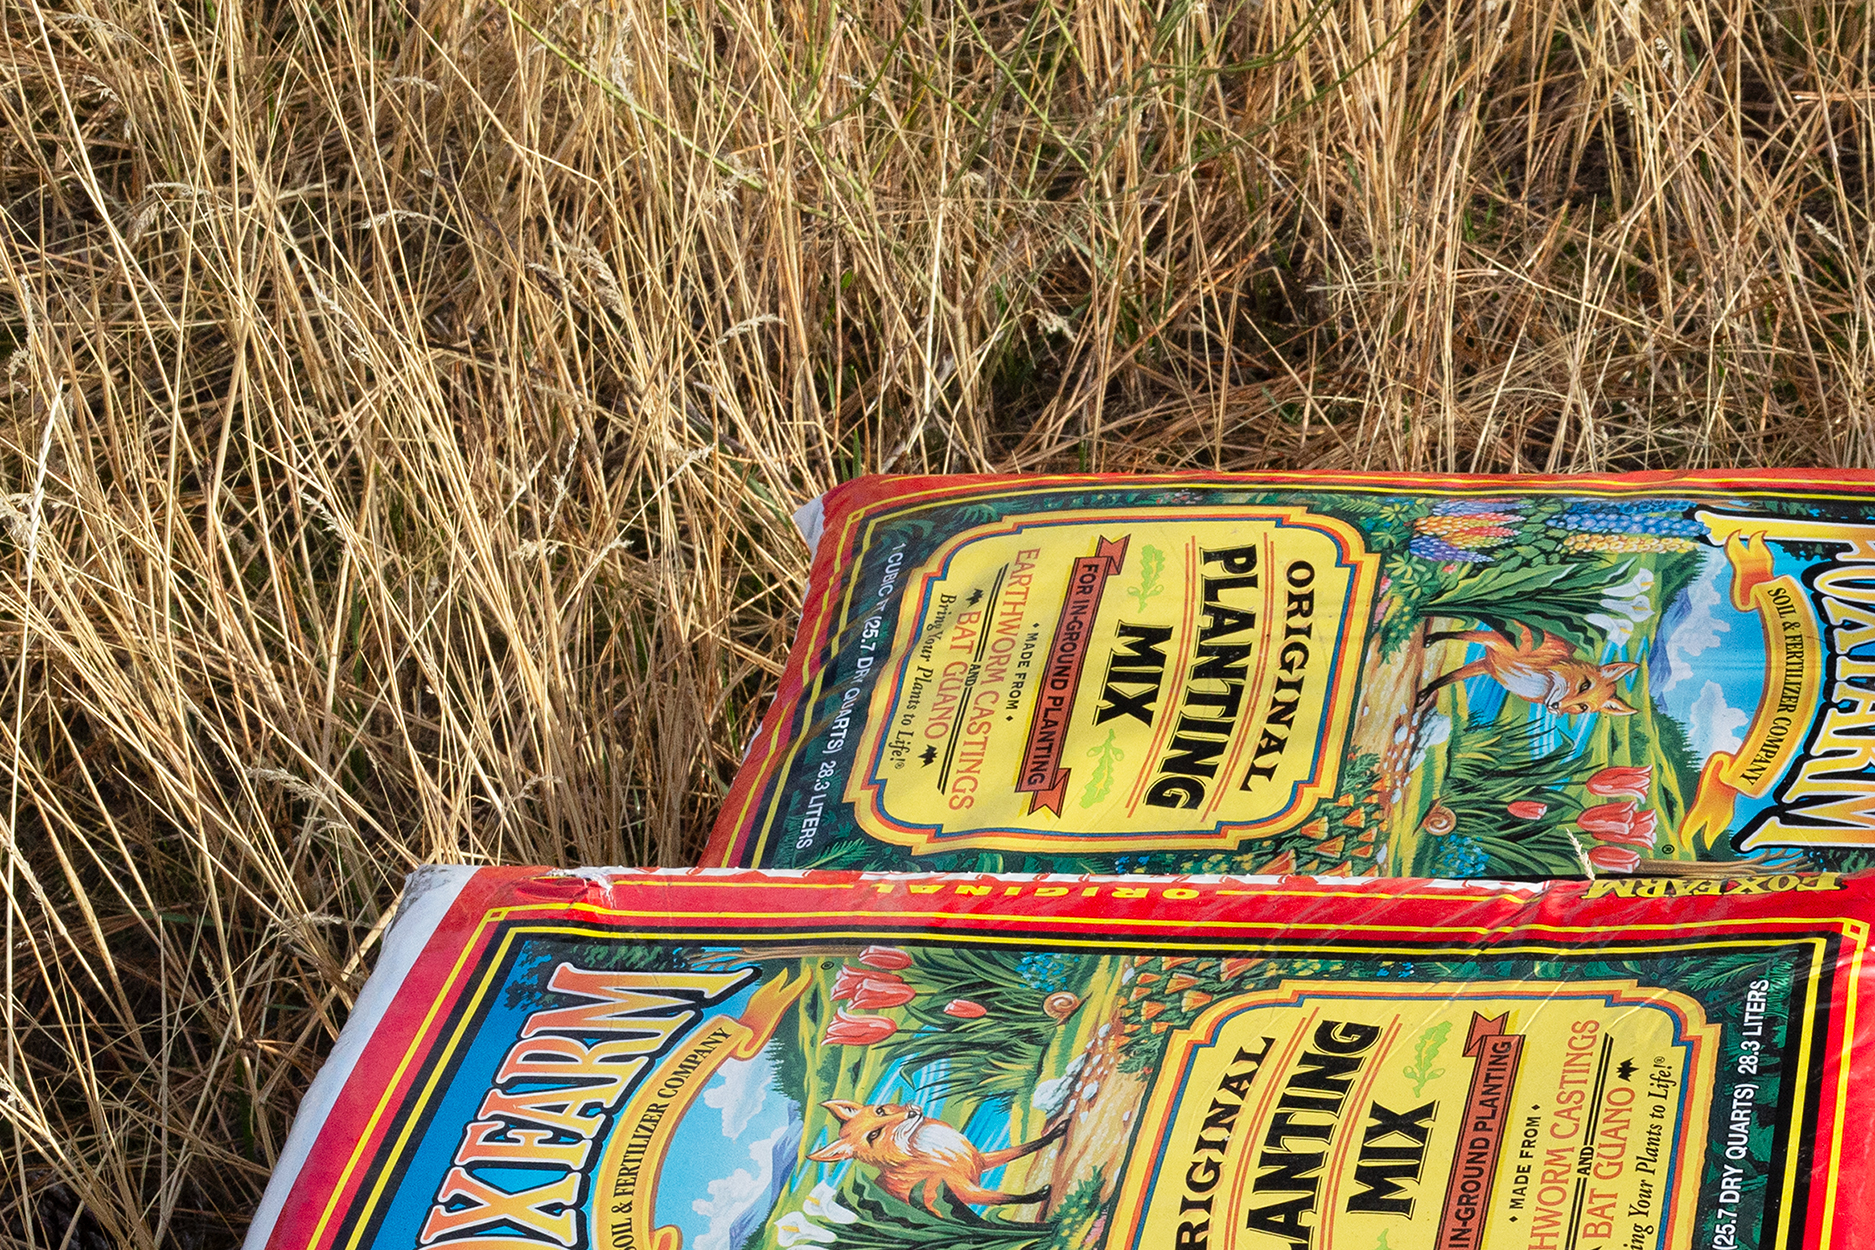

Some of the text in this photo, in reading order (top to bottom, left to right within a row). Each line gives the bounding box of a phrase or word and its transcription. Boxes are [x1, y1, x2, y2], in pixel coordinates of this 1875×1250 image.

[796, 551, 904, 850] CUBIC (25.7 DRY QUARTS) 28.3 LITERS
[901, 593, 957, 726] Bring Your Plants to
[925, 610, 975, 740] BAT GUANO
[948, 547, 1041, 811] EARTHWORM CASTINGS
[964, 662, 982, 687] AND
[1005, 632, 1039, 711] MADE FROM
[1026, 563, 1099, 786] FOR IN-GROUND PLANTING
[1091, 619, 1174, 728] MIX
[1143, 543, 1259, 810] PLANTING
[1236, 559, 1316, 792] ORIGINAL
[1739, 586, 1803, 786] SOIL & FERTILIZER COMPANY
[872, 882, 1198, 899] ORIGINAL
[1743, 979, 1770, 1037] LITERS
[657, 1026, 732, 1101] COMPANY
[1550, 1019, 1600, 1140] CASTINGS
[1738, 1040, 1761, 1075] 28.3
[613, 1102, 663, 1198] FERTILIZER
[1448, 1137, 1489, 1250] IN-GROUND
[1473, 1041, 1512, 1132] PLANTING
[1637, 1124, 1661, 1175] Plants
[1652, 1104, 1666, 1119] to
[1725, 1084, 1759, 1160] QUARTS)
[612, 1196, 632, 1214] &
[1346, 1099, 1440, 1220] MIX
[1509, 1116, 1539, 1210] MADE FROM
[1577, 1145, 1595, 1177] AND
[1582, 1087, 1635, 1239] BAT GUANO
[1629, 1179, 1652, 1218] Your
[1719, 1167, 1744, 1203] DRY
[1712, 1208, 1739, 1250] (25.7
